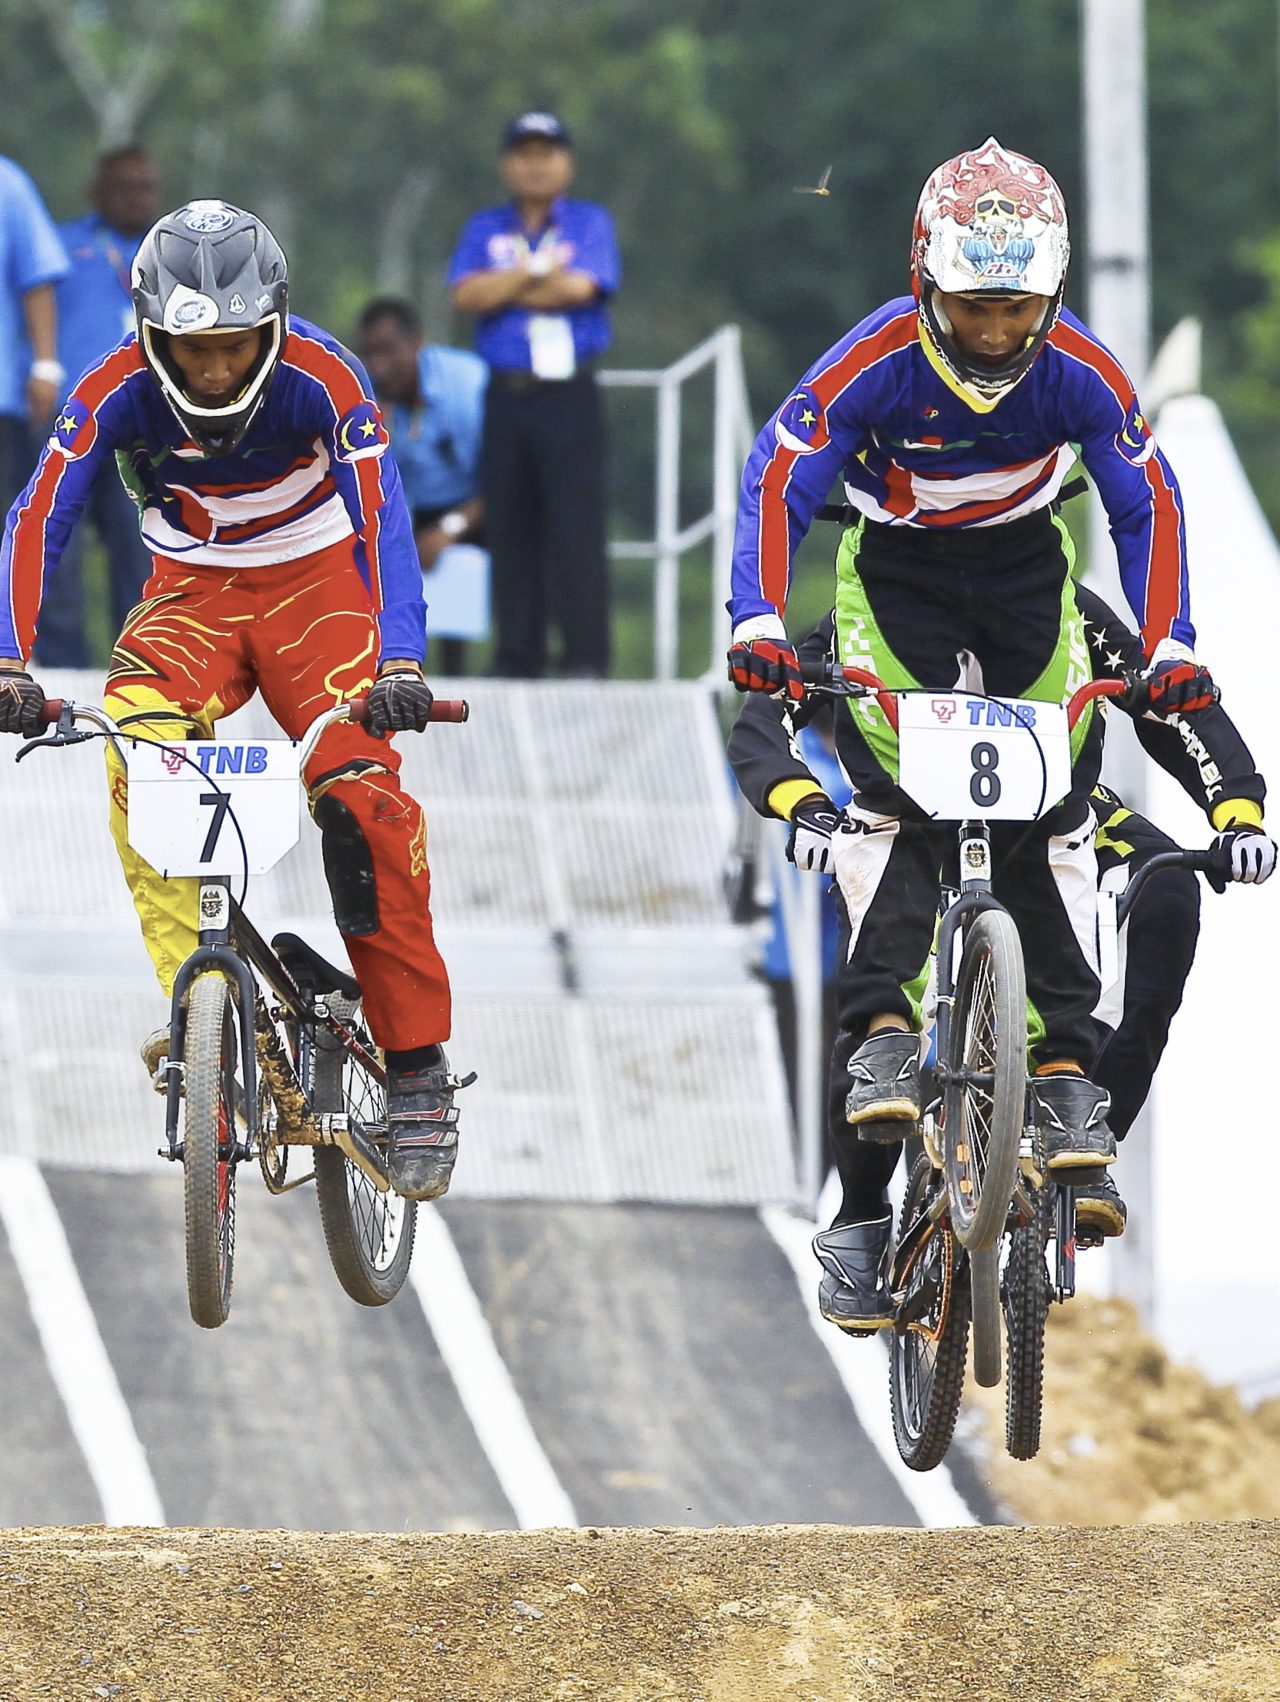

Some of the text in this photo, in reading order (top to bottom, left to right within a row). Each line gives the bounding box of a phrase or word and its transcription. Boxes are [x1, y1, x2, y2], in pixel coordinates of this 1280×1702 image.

[966, 701, 1037, 729] TNB
[196, 746, 269, 774] TNB
[969, 741, 1002, 808] 8
[199, 793, 231, 863] 7
